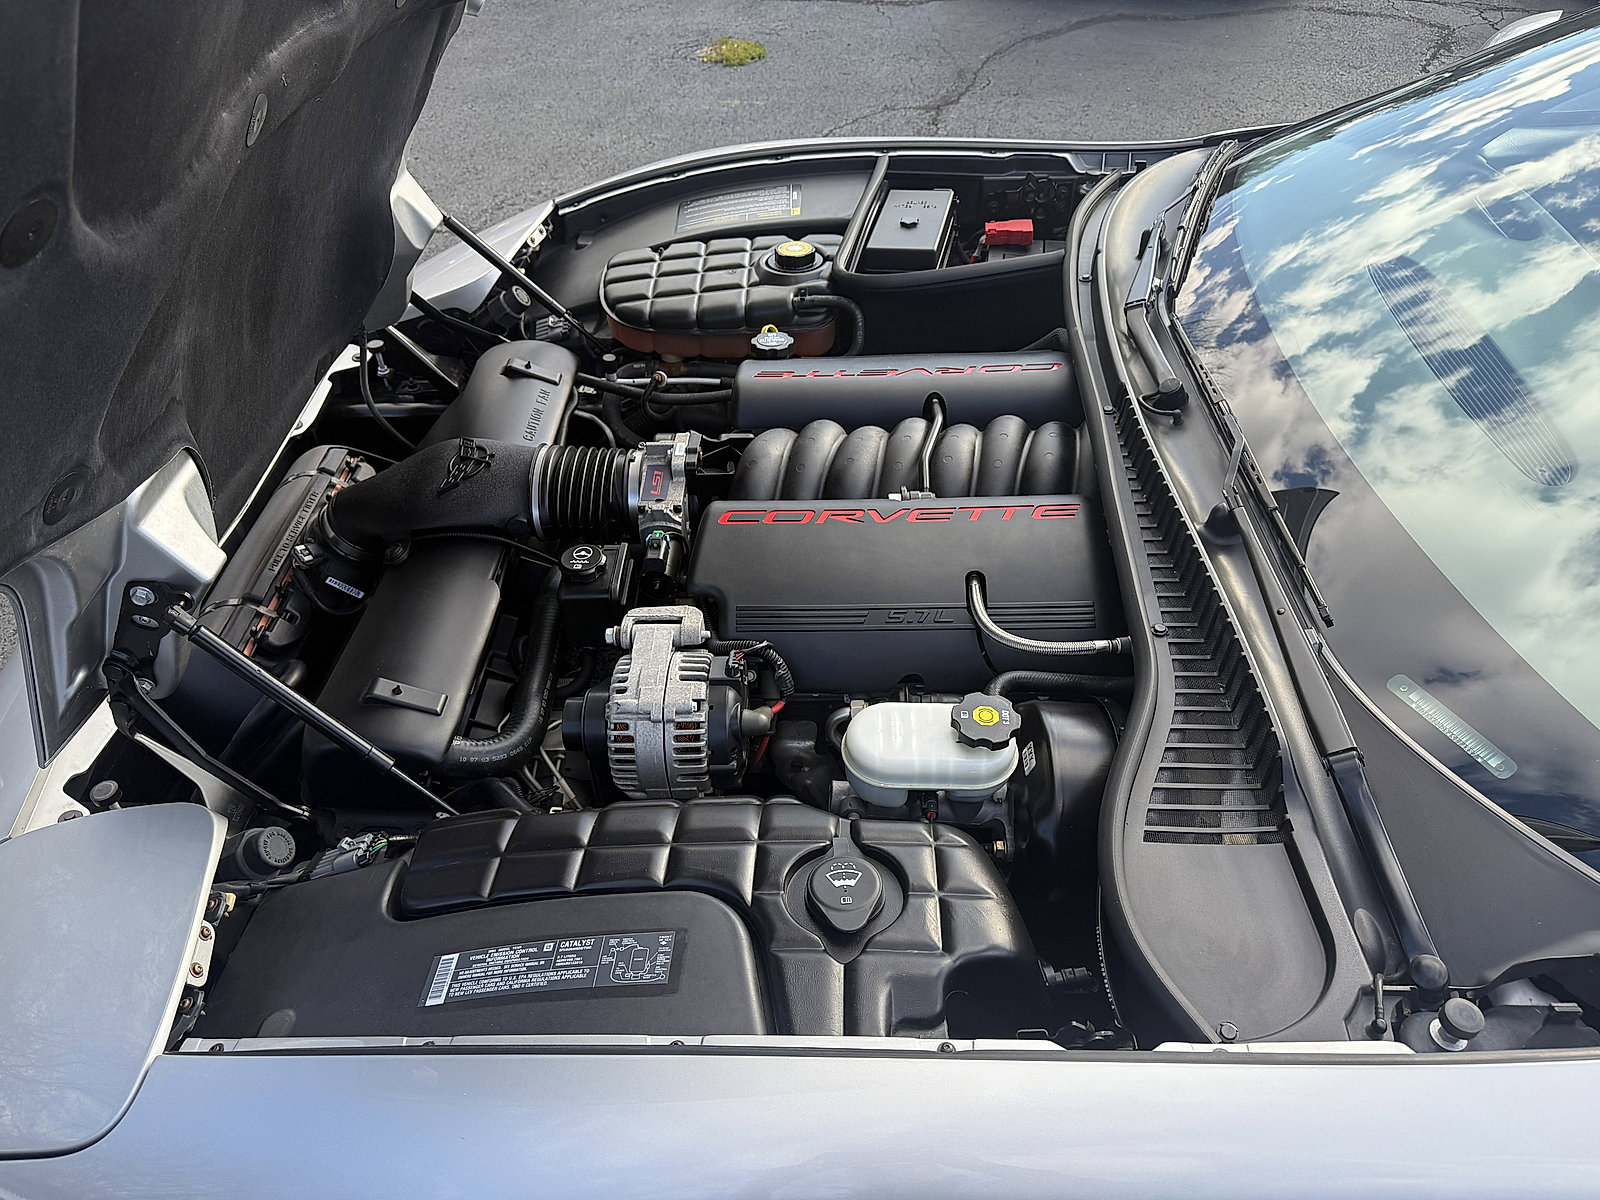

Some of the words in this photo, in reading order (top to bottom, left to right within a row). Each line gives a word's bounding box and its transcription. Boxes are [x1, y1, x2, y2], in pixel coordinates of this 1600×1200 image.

[752, 362, 1063, 378] CORVETTE
[522, 406, 545, 442] CAUTION
[536, 388, 550, 406] FAN
[650, 470, 664, 496] LS1
[718, 504, 1081, 525] CORVETTE
[885, 609, 954, 624] 5.7L
[560, 939, 595, 948] CATALYST
